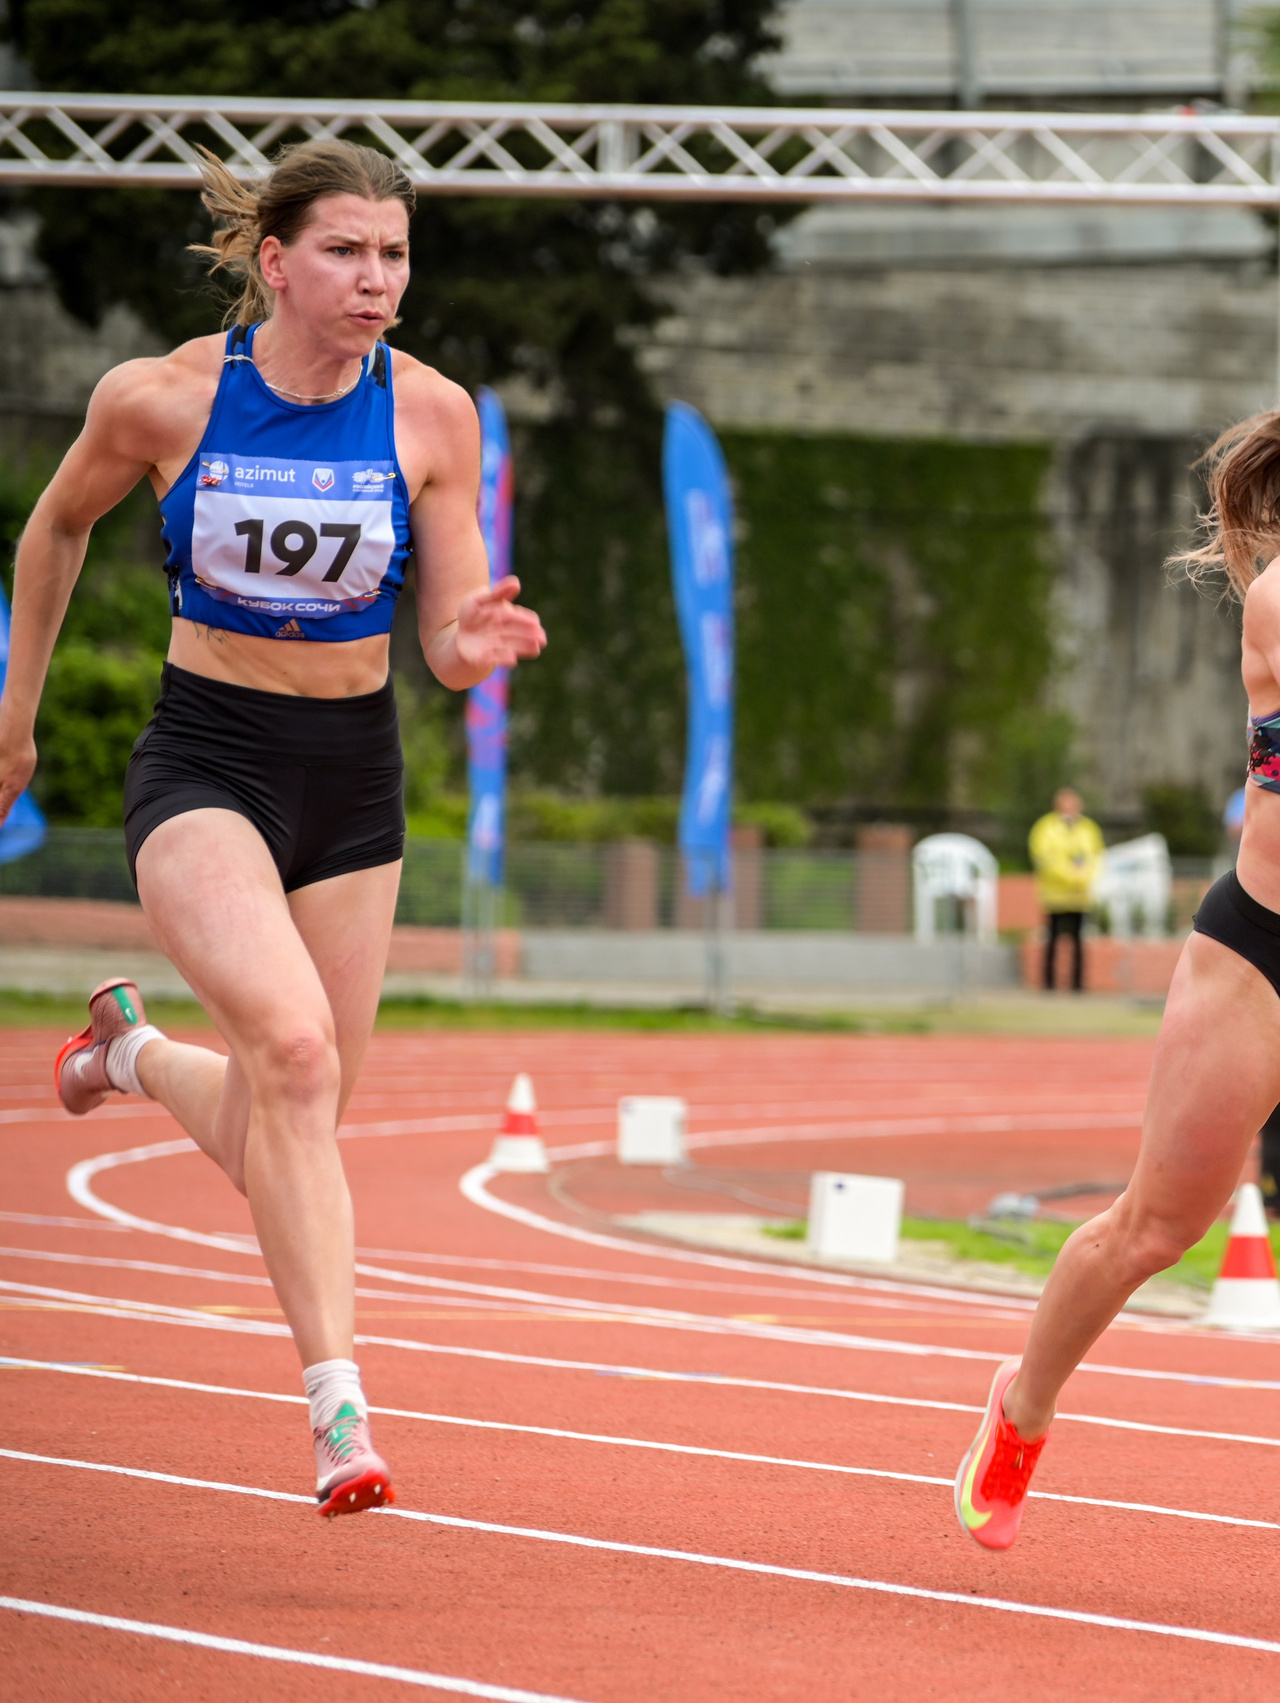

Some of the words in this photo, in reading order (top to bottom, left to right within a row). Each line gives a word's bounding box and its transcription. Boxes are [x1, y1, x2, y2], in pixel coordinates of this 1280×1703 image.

[234, 465, 296, 482] azimut
[234, 518, 362, 583] 197
[237, 597, 294, 611] КУБОК
[294, 602, 341, 612] СОЧИ
[275, 630, 305, 638] adidas
